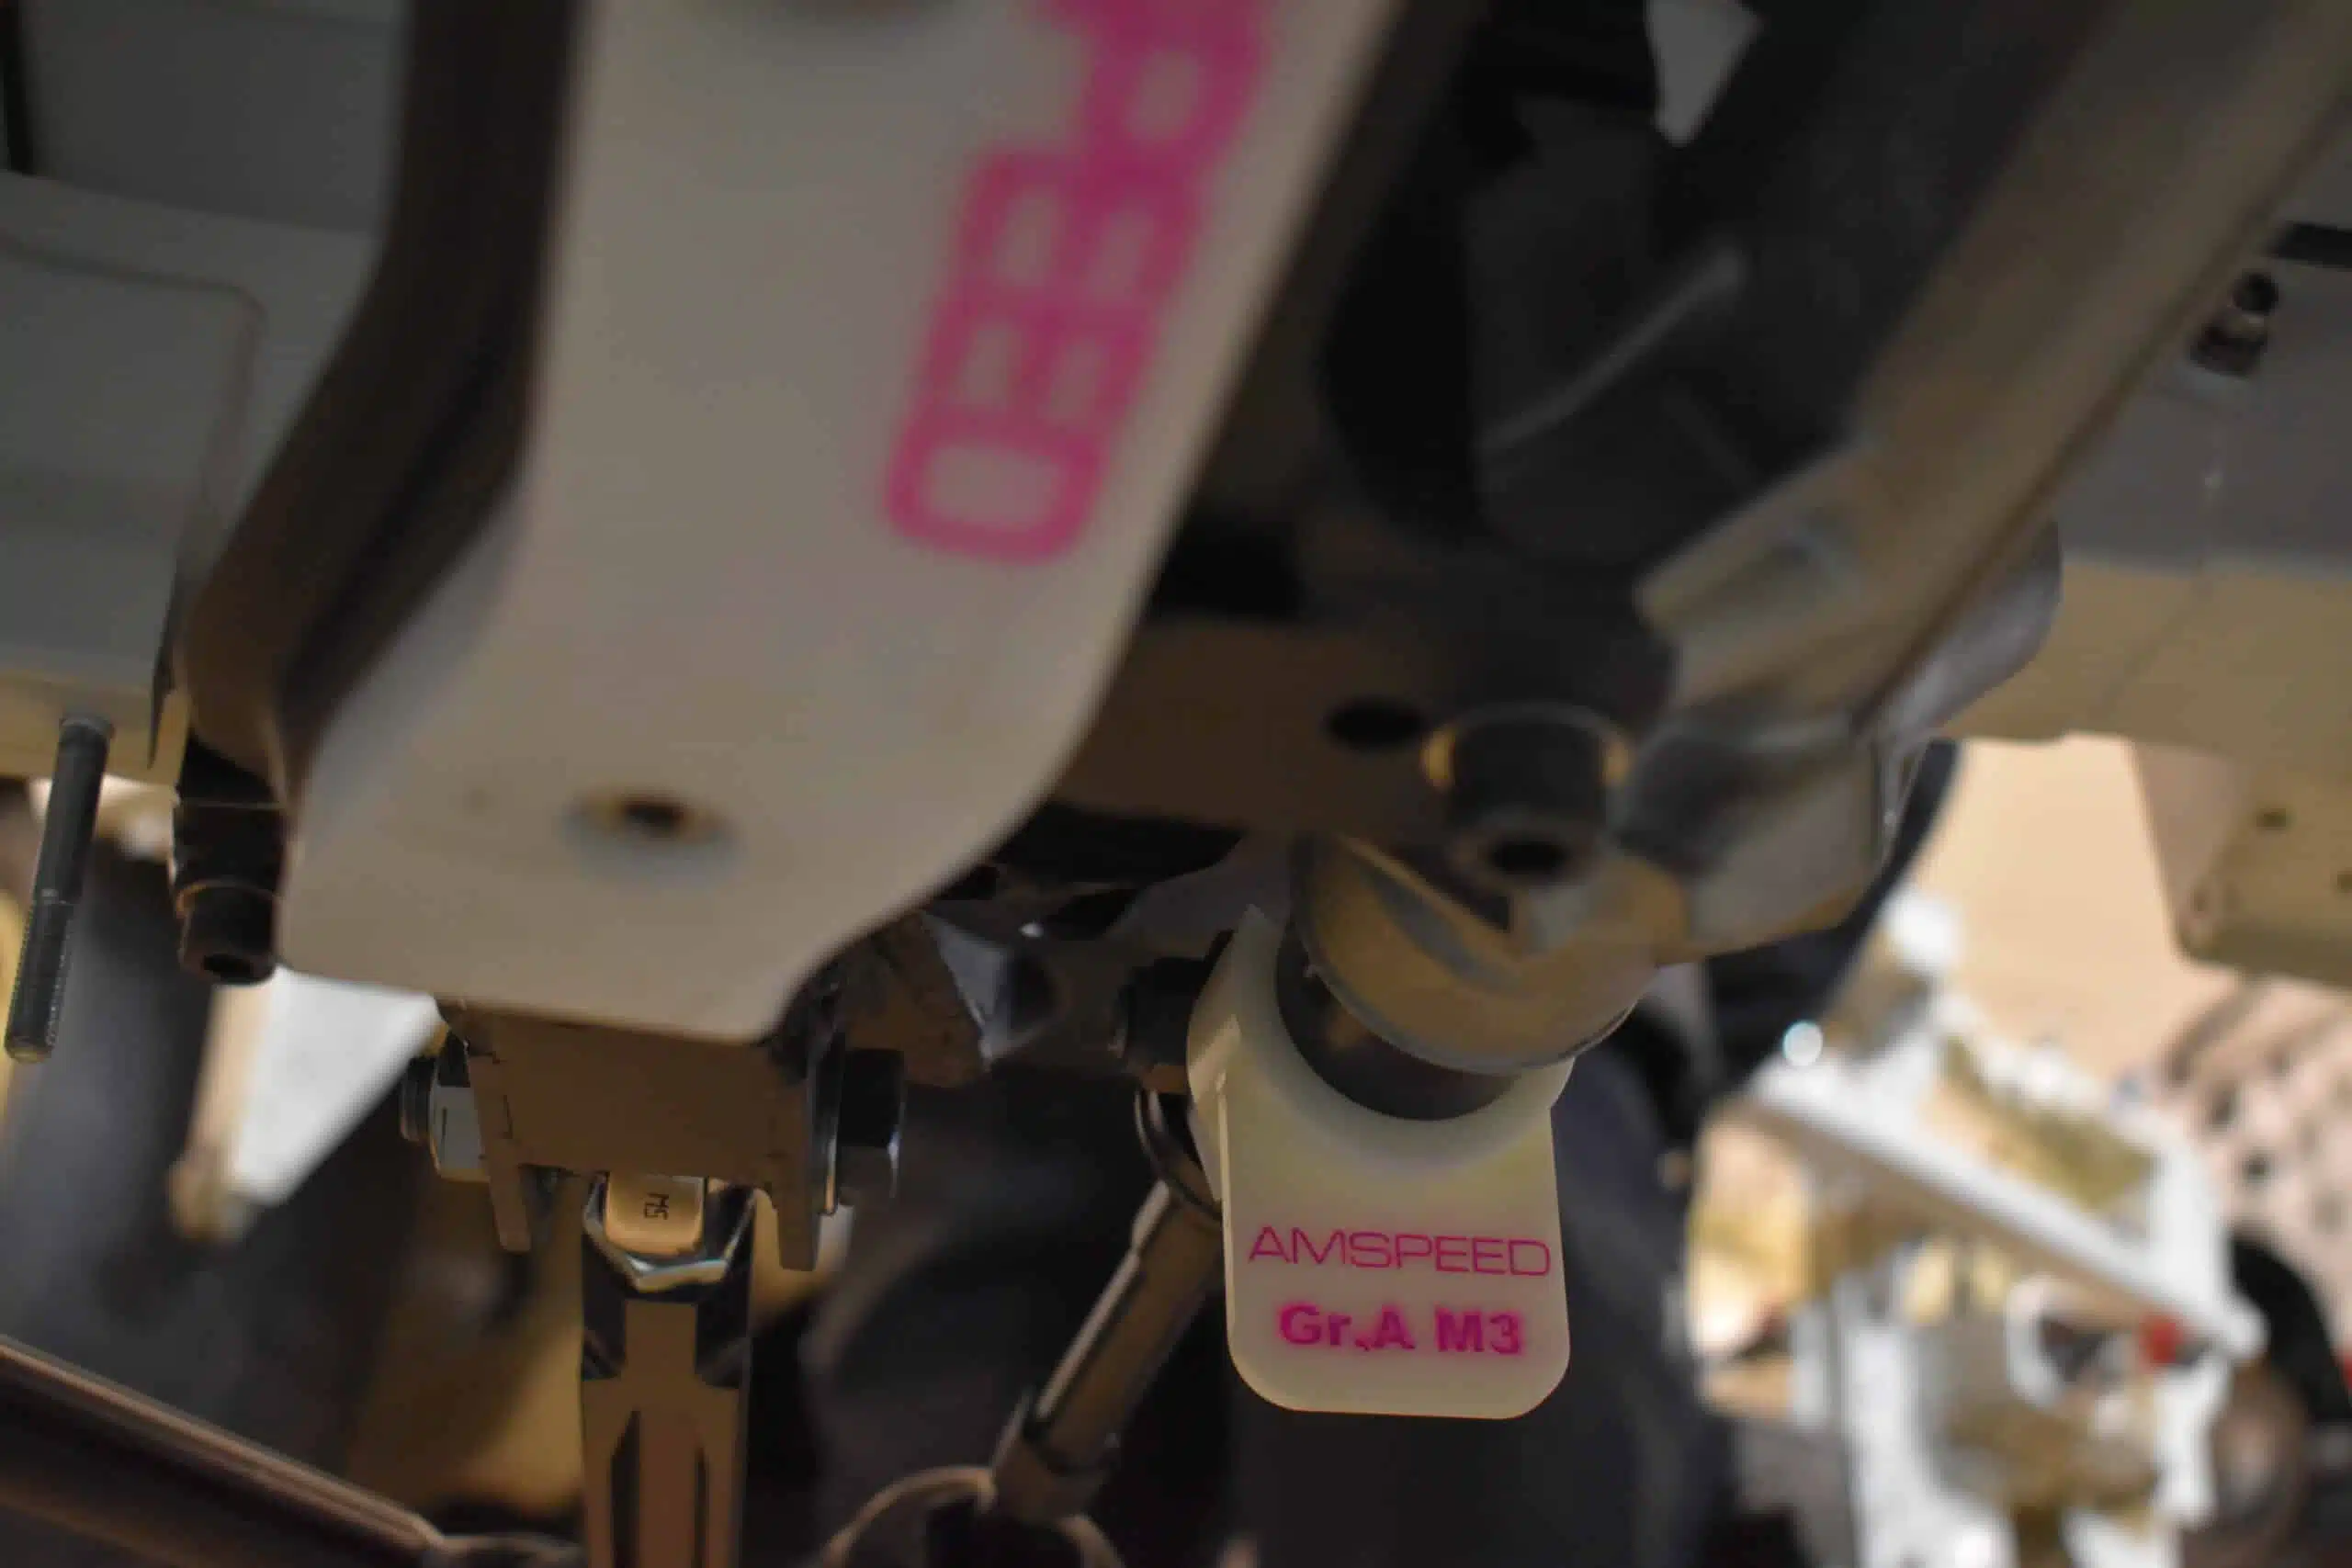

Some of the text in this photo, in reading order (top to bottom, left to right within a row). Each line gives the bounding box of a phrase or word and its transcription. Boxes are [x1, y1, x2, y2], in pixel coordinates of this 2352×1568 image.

[885, 0, 1271, 563] PEED
[1249, 1225, 1551, 1277] AMSPEED
[1434, 1306, 1524, 1355] M3
